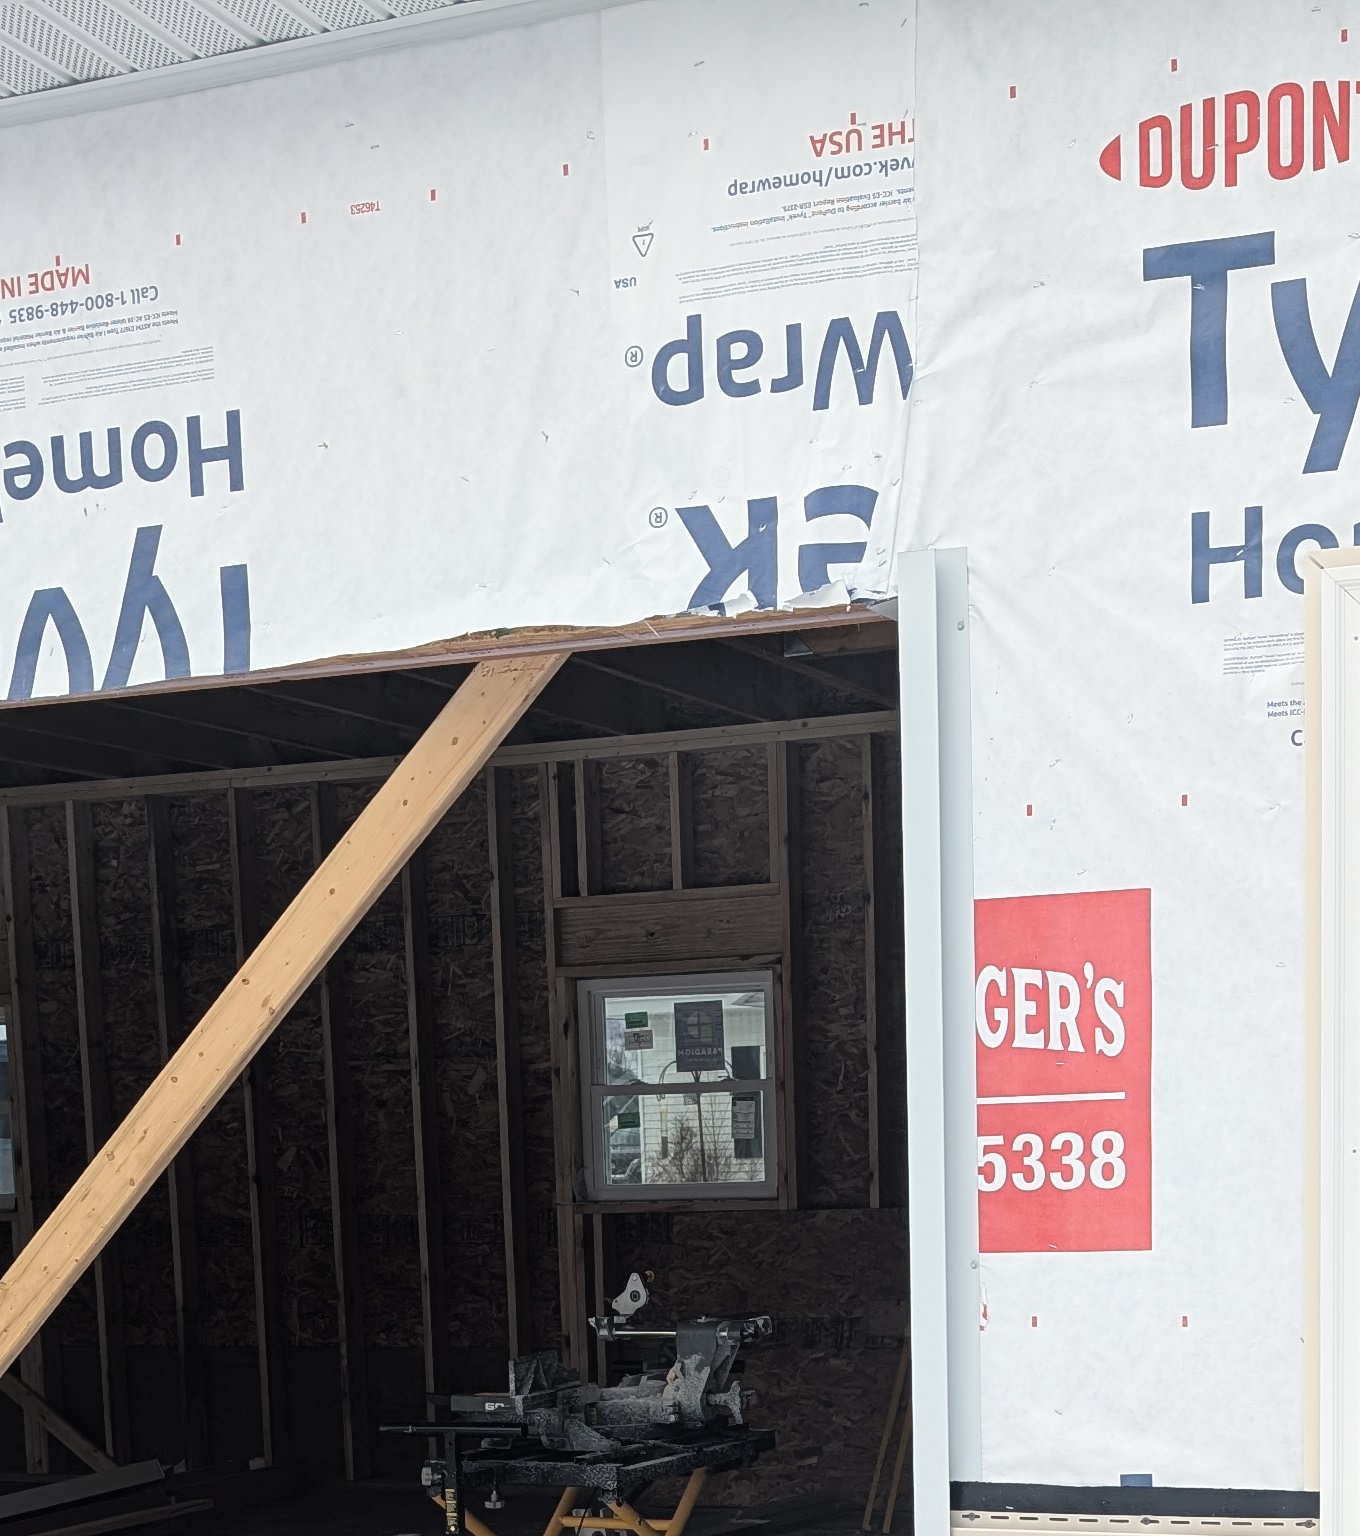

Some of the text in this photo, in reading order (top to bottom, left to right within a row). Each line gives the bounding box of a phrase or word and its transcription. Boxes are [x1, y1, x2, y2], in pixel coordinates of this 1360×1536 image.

[808, 128, 863, 158] USA
[350, 201, 381, 216] T46253
[0, 276, 22, 300] IN
[28, 264, 92, 296] MADE
[131, 285, 159, 305] Call
[614, 277, 637, 290] USA
[9, 290, 128, 324] 1-800-448-9835
[975, 961, 1126, 1058] GER'S
[976, 1129, 1127, 1192] 5338
